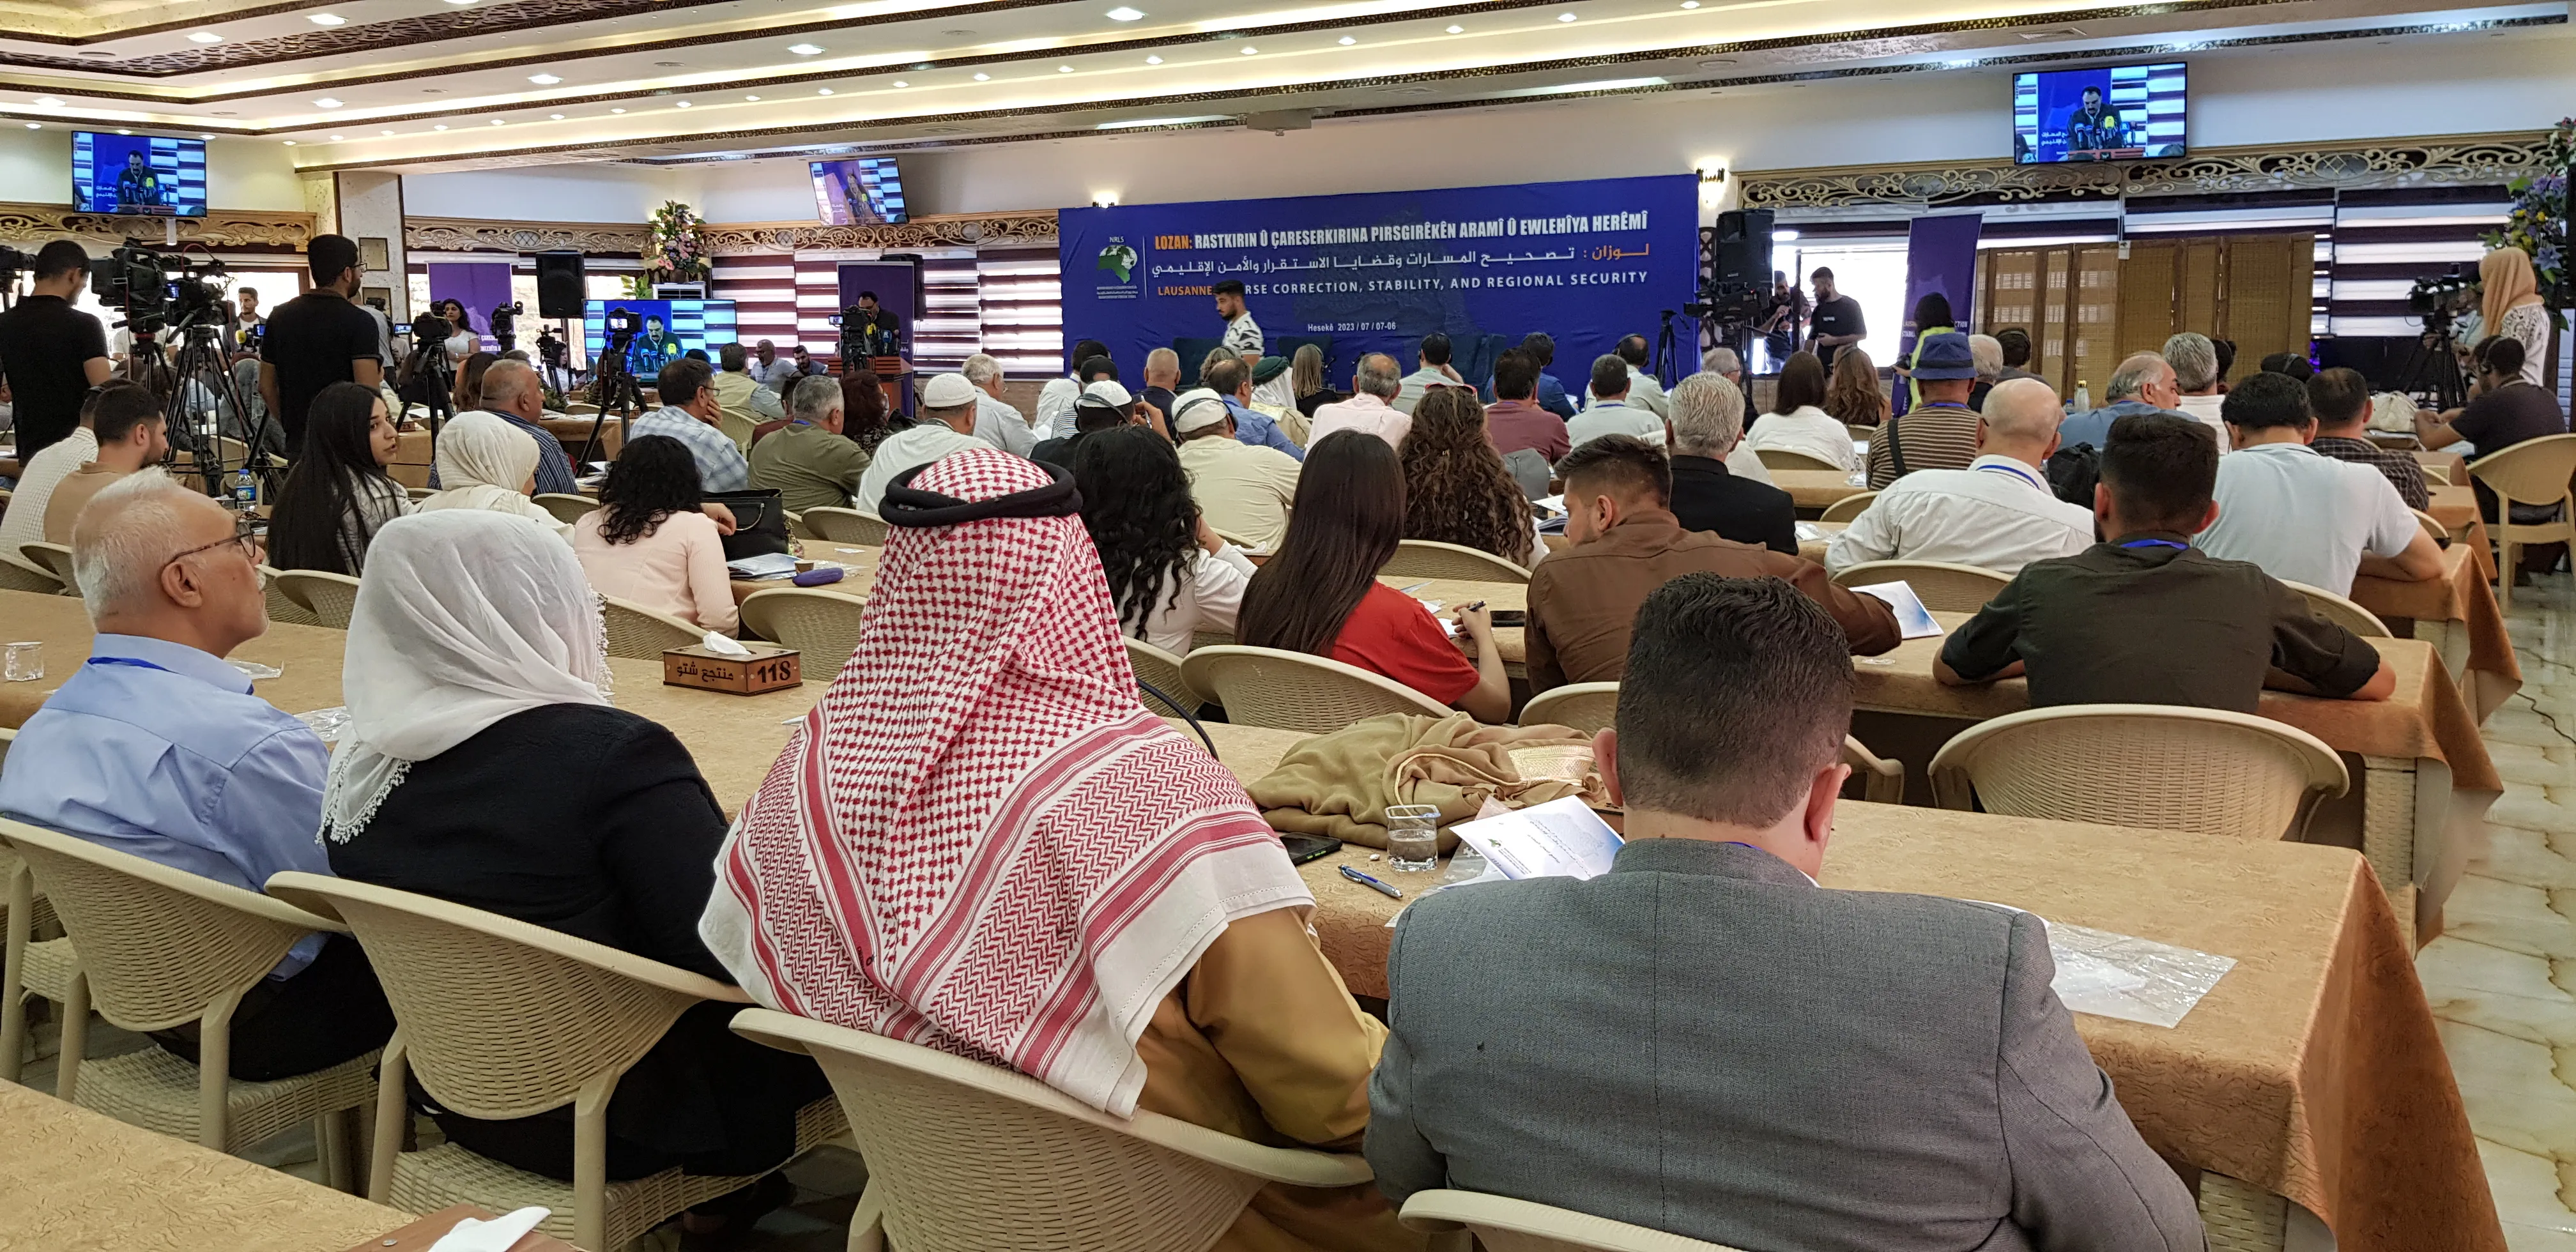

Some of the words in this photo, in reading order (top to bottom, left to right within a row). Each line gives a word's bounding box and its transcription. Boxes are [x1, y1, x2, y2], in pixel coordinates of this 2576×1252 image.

[1154, 235, 1193, 250] LOZAN:
[1194, 233, 1257, 249] RASTKIRIN
[1259, 229, 1268, 247] Û
[1271, 227, 1368, 249] ÇARESERKIRINA
[1370, 220, 1456, 242] PIRSGIRÊKÊN
[1459, 217, 1505, 238] ARAMÎ
[1506, 217, 1517, 236] Û
[1520, 214, 1589, 236] EWLEHÎYA
[1591, 210, 1648, 232] HERÊMÎ
[1245, 284, 1268, 294] RSE
[1273, 281, 1363, 294] CORRECTION,
[1368, 278, 1444, 292] STABILITY,
[1450, 277, 1480, 289] AND
[1487, 275, 1564, 287] REGIONAL
[1570, 271, 1648, 286] SECURITY
[1308, 323, 1334, 332] Hesekê
[1338, 323, 1354, 332] 2023
[1361, 322, 1369, 330] 07
[1376, 321, 1397, 330] 07-06
[677, 661, 698, 677] شتو
[702, 667, 734, 683] منتجع
[757, 660, 791, 683] 118
